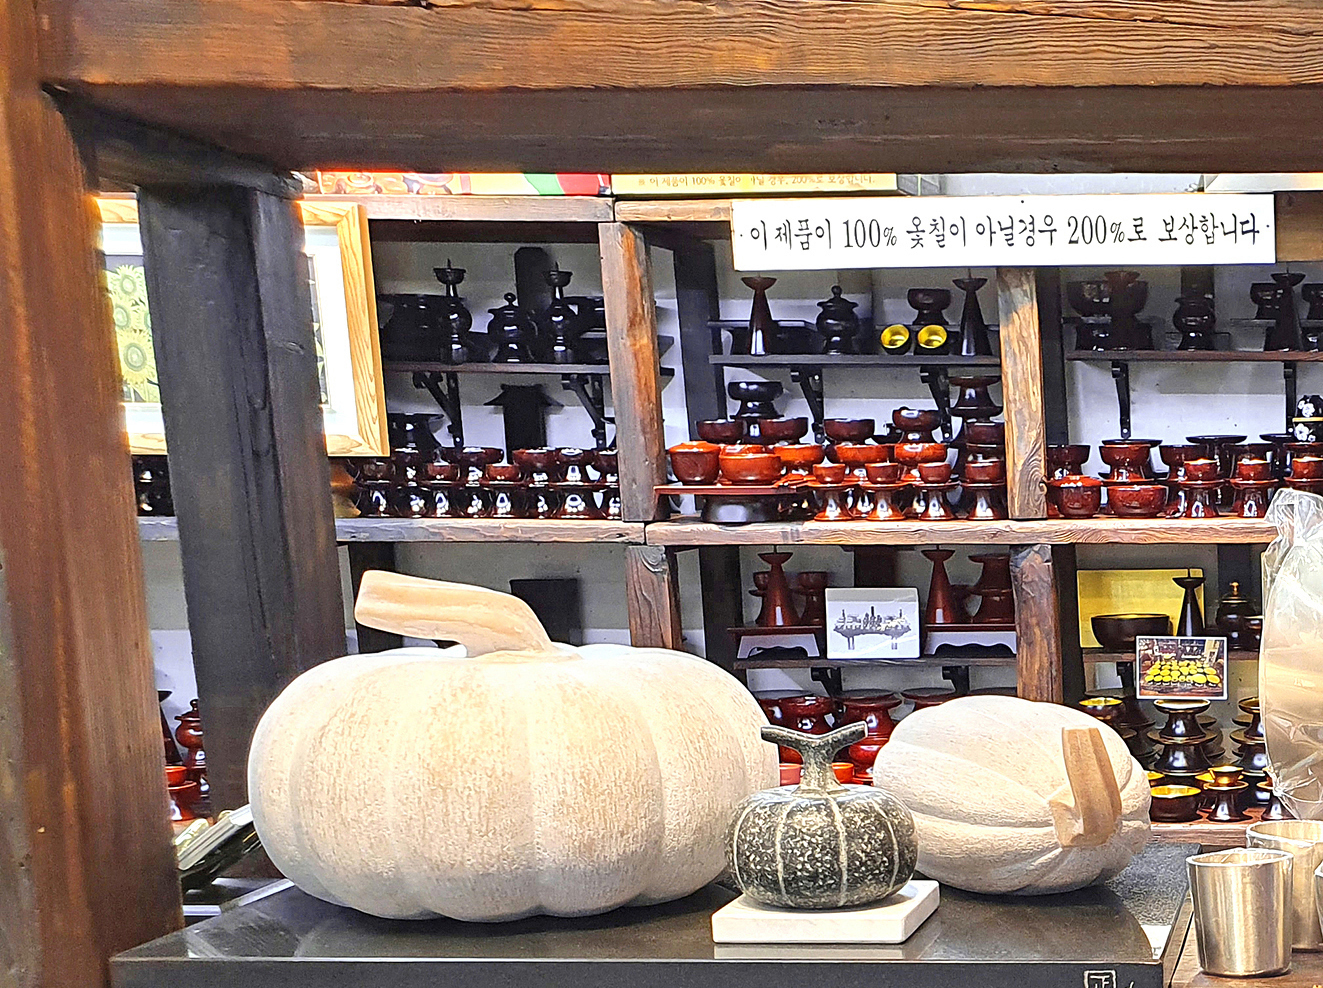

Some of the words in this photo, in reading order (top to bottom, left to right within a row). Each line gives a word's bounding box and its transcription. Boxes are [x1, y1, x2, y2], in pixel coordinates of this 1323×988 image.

[649, 176, 659, 187] 이
[661, 176, 688, 187] 제품이
[691, 176, 716, 186] 100%
[750, 219, 767, 250] 이
[774, 218, 831, 251] 제품이
[843, 217, 897, 247] 100%
[905, 215, 966, 249] 옻칠이
[1067, 215, 1147, 245] 200%로
